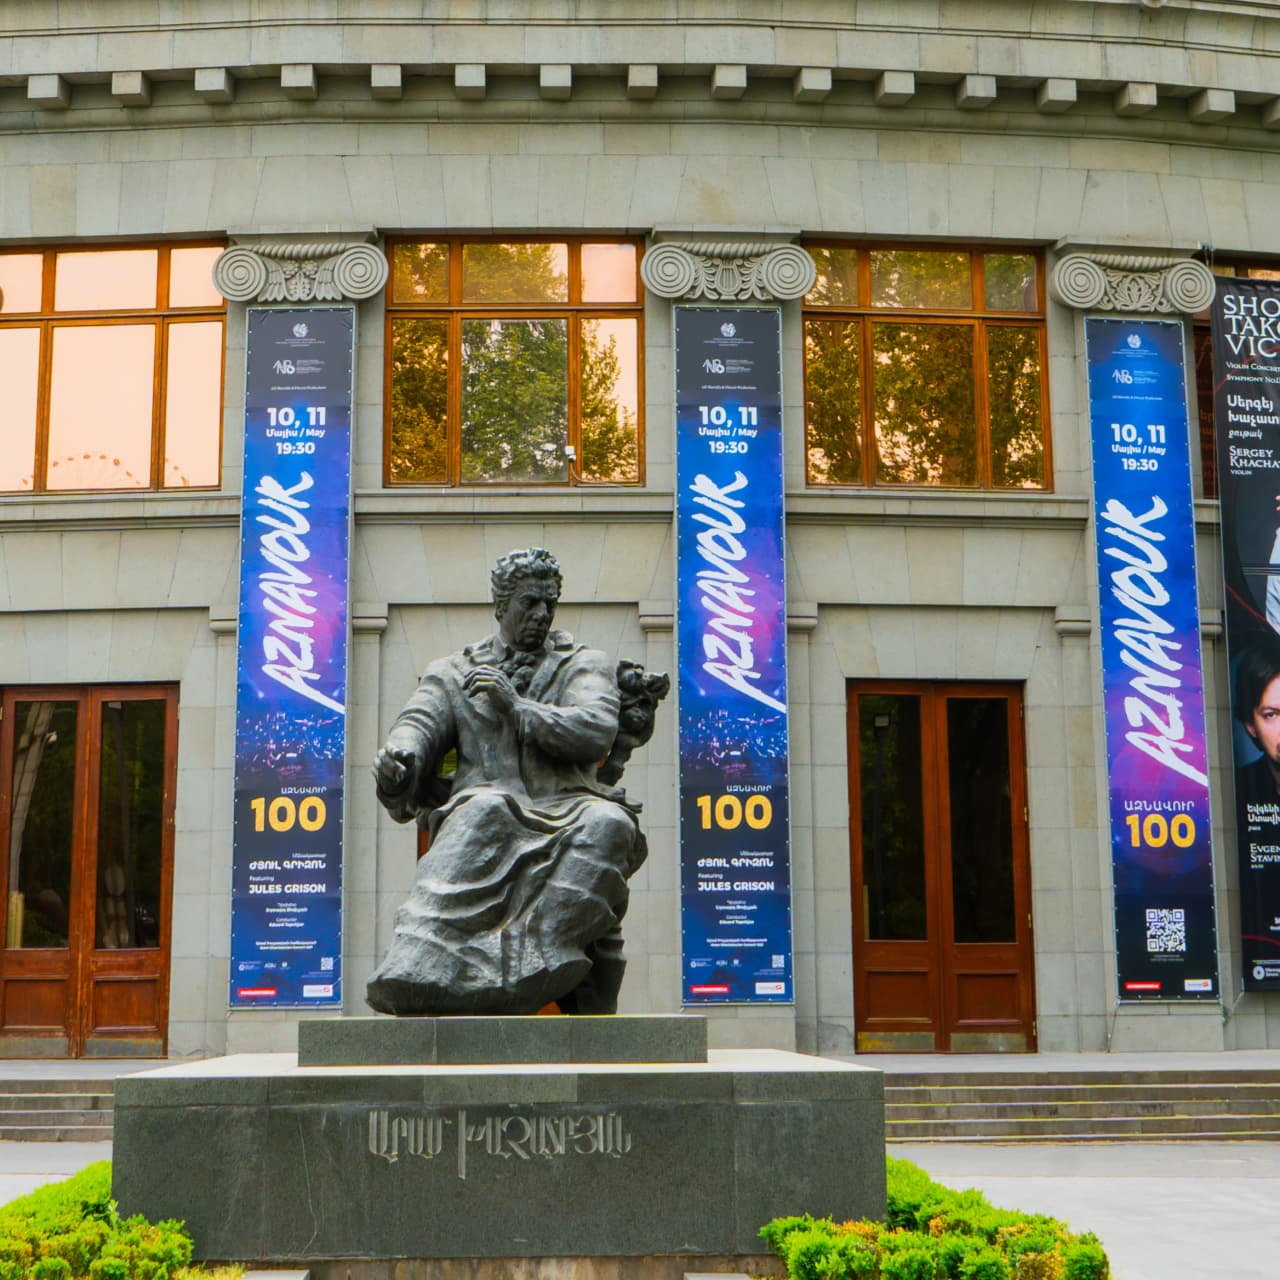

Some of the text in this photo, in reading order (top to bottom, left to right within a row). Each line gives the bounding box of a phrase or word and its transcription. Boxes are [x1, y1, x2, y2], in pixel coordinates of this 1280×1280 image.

[267, 407, 326, 427] 10, 11
[699, 406, 758, 427] 10, 11
[305, 428, 326, 438] May
[738, 428, 758, 438] May
[1111, 423, 1166, 445] 10, 11
[276, 442, 315, 455] 19:30
[709, 441, 748, 454] 19:30
[1148, 446, 1166, 457] May
[1121, 458, 1159, 471] 19:30
[254, 470, 345, 715] AZNAVOUR
[689, 470, 787, 714] AZNAVOUR
[1100, 494, 1209, 787] AZNAVOUR
[250, 796, 327, 832] 100
[696, 794, 773, 830] 100
[1125, 813, 1196, 848] 100
[249, 883, 327, 895] JULES GRISON
[698, 881, 775, 892] JULES GRISON
